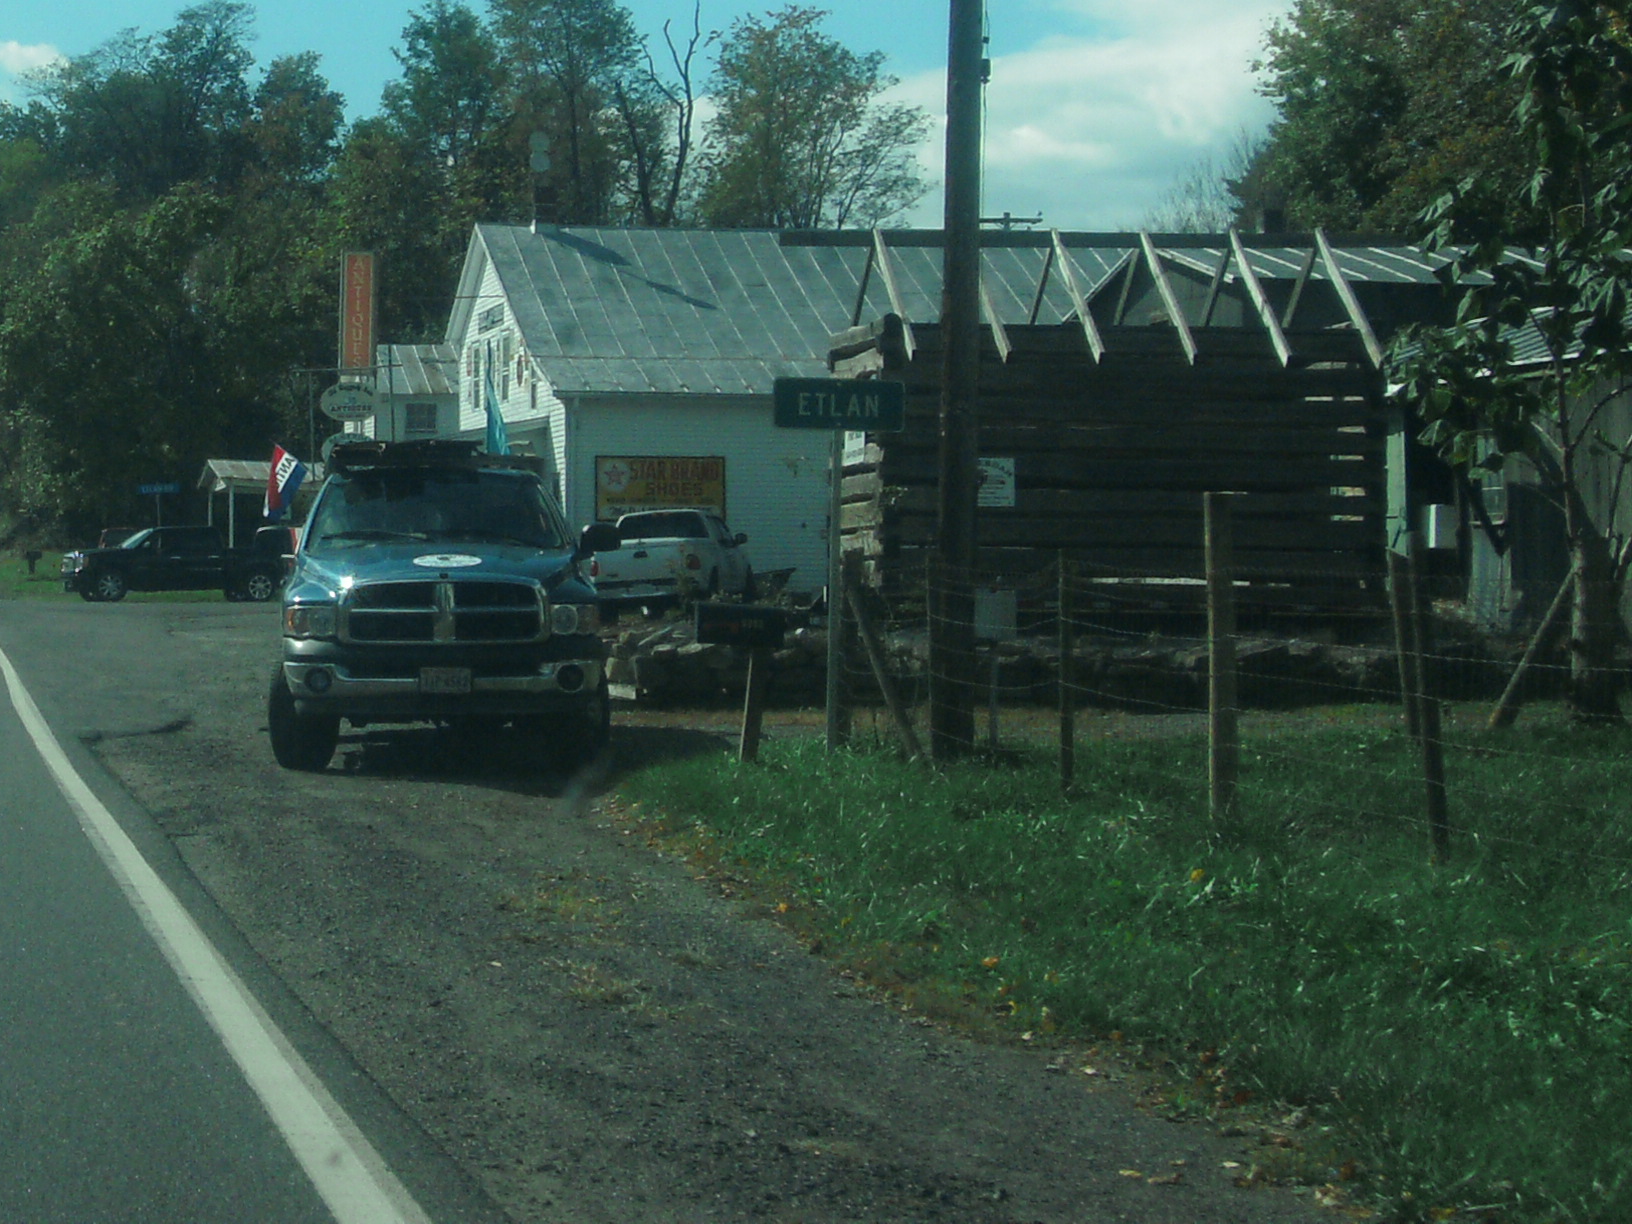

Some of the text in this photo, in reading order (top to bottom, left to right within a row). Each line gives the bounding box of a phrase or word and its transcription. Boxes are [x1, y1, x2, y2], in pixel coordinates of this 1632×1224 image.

[351, 257, 365, 370] ANTIQUES
[798, 392, 880, 418] ETLAN
[629, 460, 720, 482] STAR BRAND
[646, 481, 704, 497] SHOES
